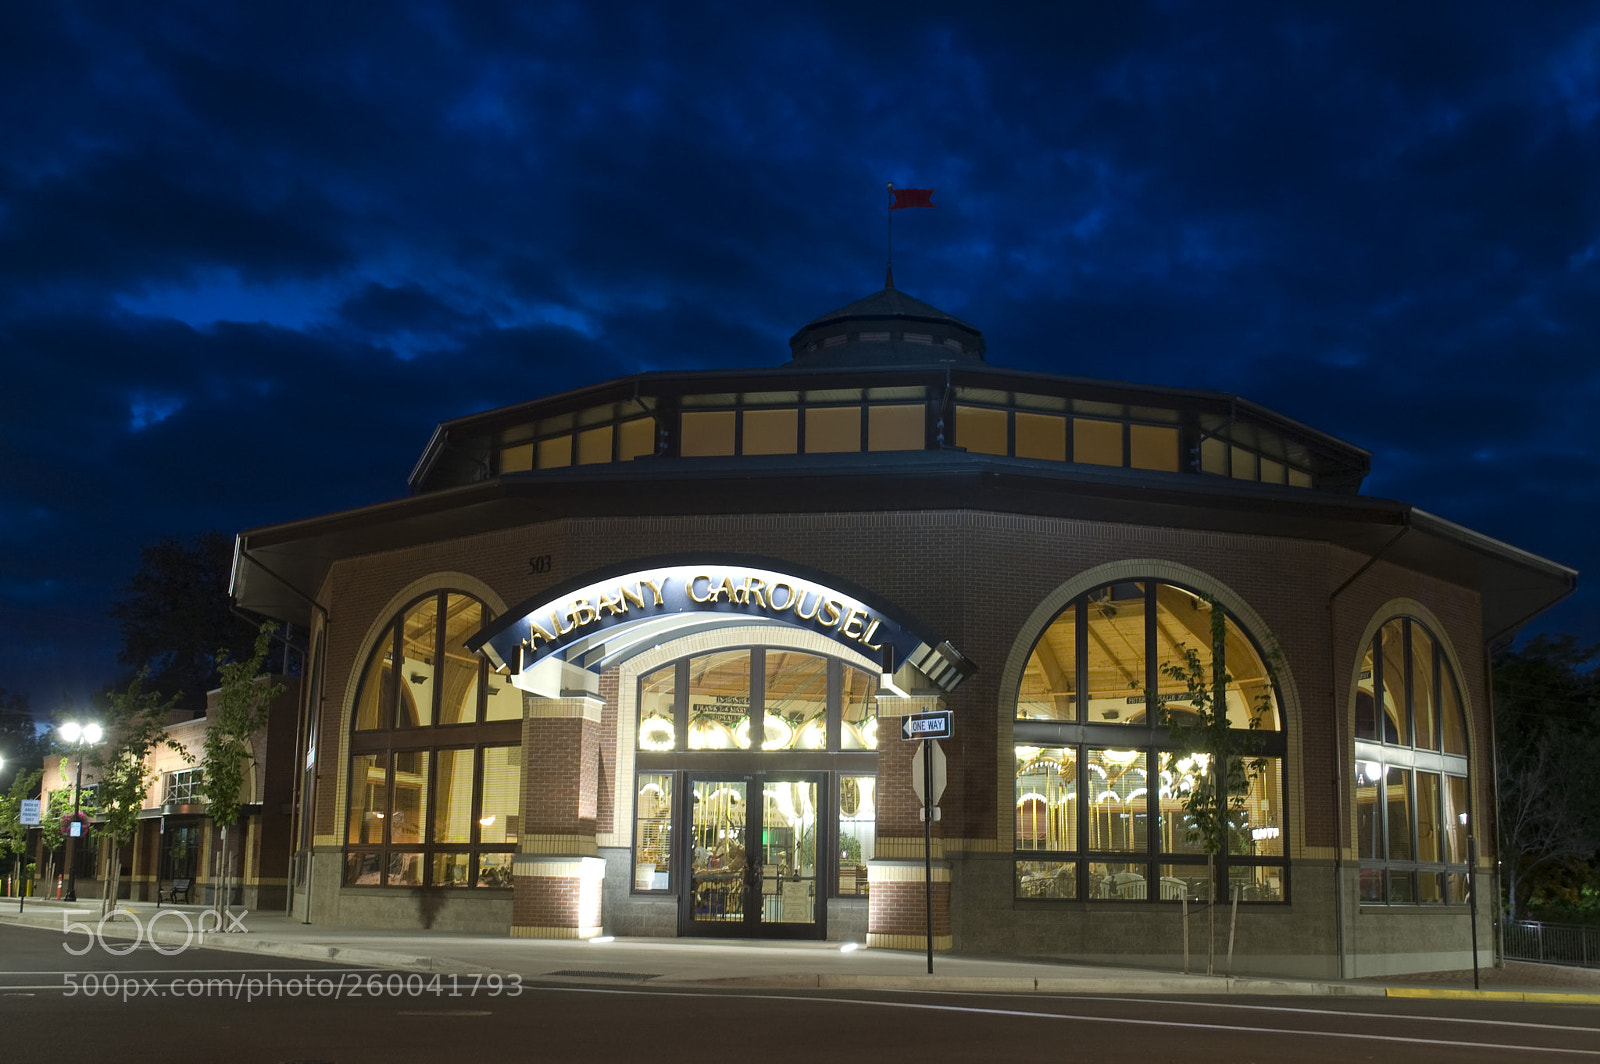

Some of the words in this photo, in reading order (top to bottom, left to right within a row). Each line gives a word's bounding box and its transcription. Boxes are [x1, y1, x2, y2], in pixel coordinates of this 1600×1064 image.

[528, 555, 551, 575] 503
[522, 577, 671, 651] ALBANY
[685, 576, 882, 650] CAROUSEL
[912, 721, 926, 731] ONE
[927, 719, 943, 730] WAY
